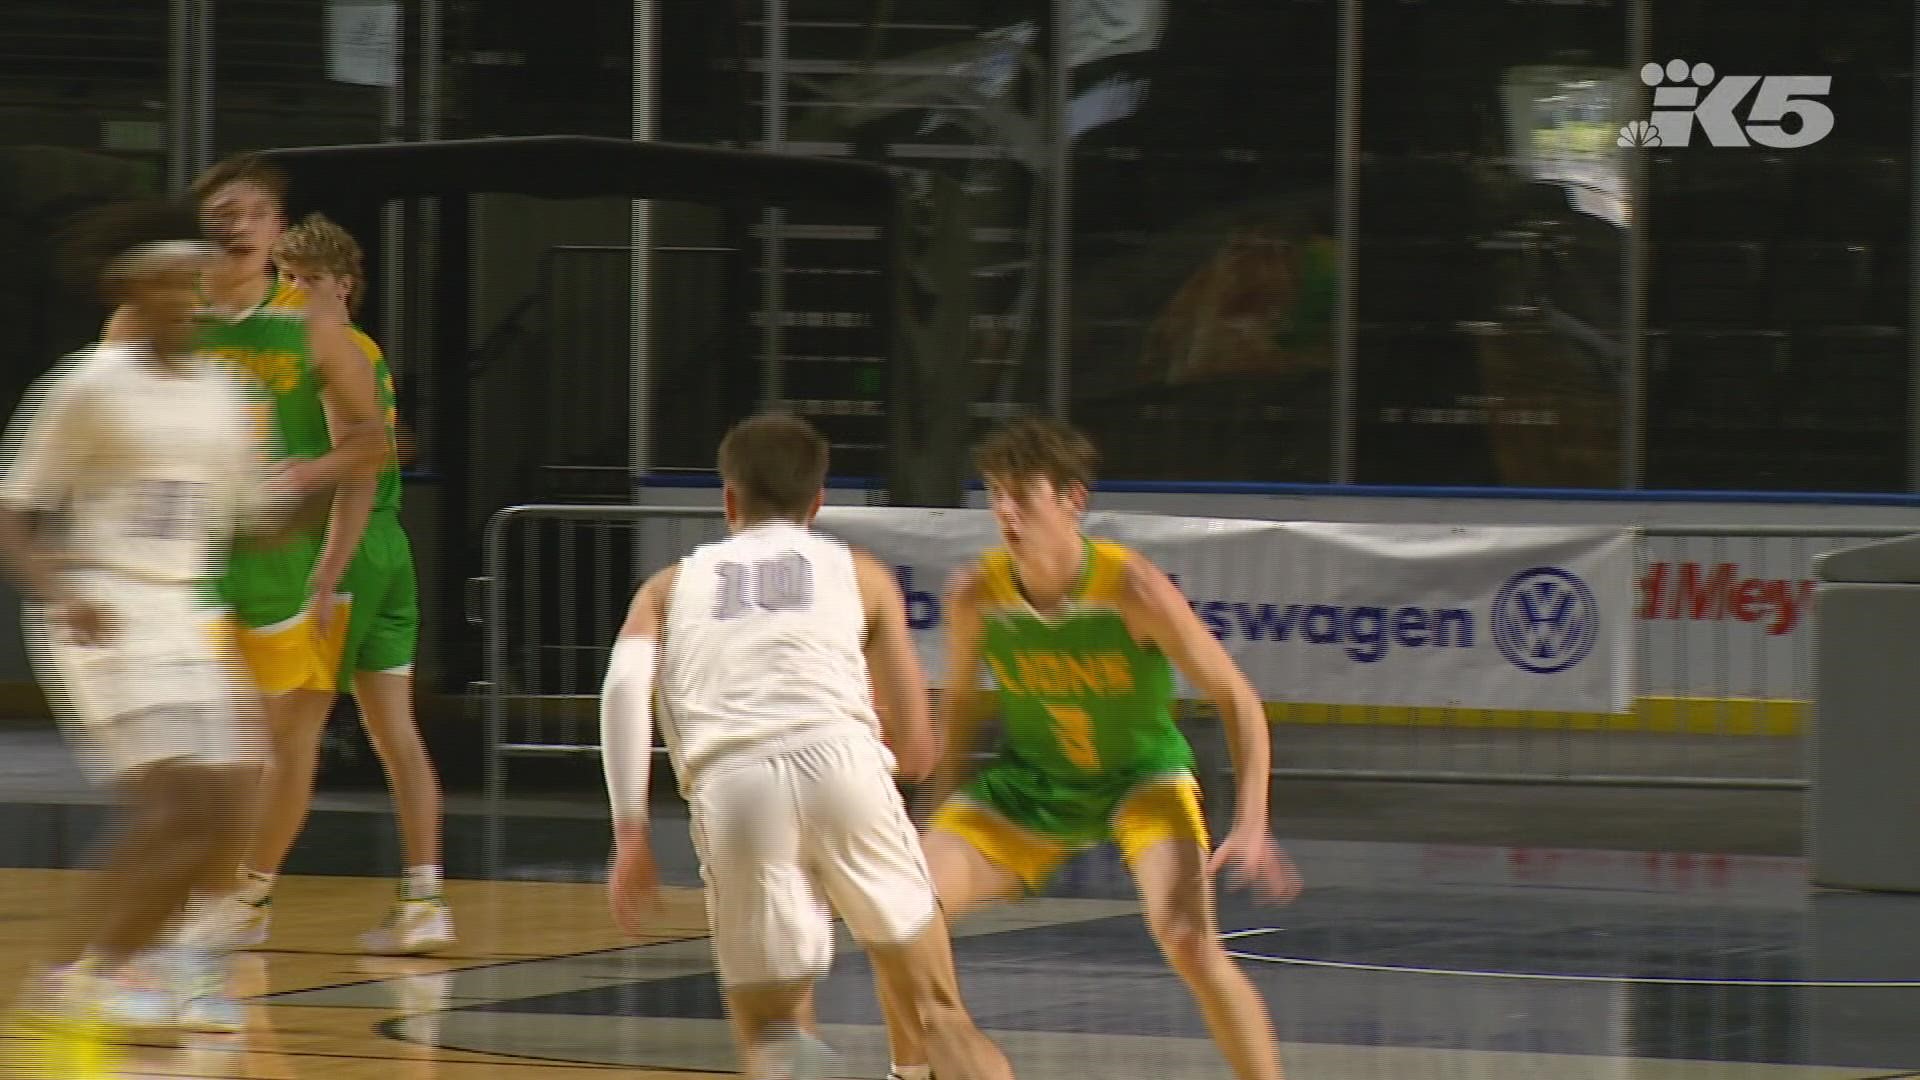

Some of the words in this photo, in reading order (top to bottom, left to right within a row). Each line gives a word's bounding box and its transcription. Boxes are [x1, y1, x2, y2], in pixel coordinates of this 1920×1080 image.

[711, 550, 814, 621] 10
[1168, 573, 1474, 663] swagen
[986, 649, 1136, 696] LIONS
